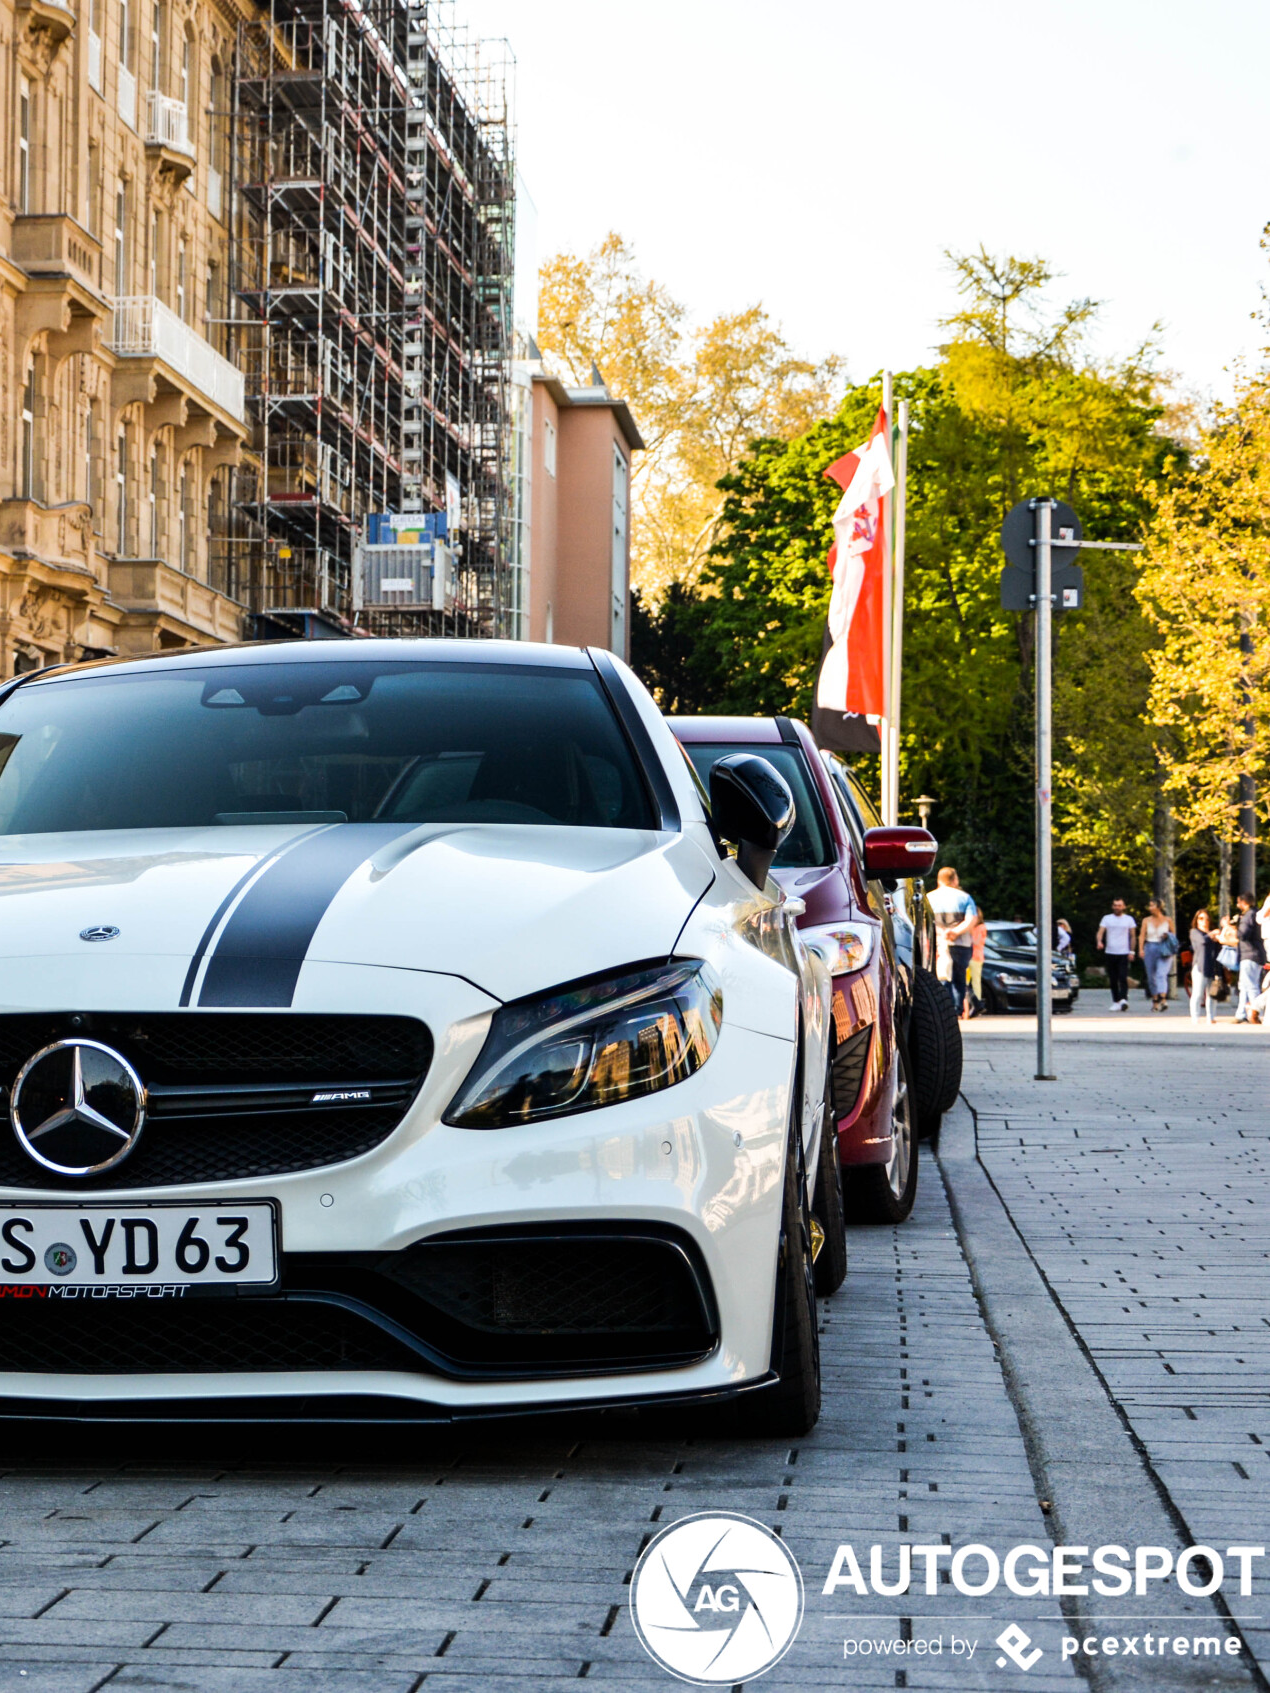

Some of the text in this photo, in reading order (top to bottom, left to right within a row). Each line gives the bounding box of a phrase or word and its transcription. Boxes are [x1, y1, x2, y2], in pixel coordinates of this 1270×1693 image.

[331, 1091, 370, 1100] AMG
[80, 1218, 159, 1275] YD
[175, 1216, 250, 1274] 63
